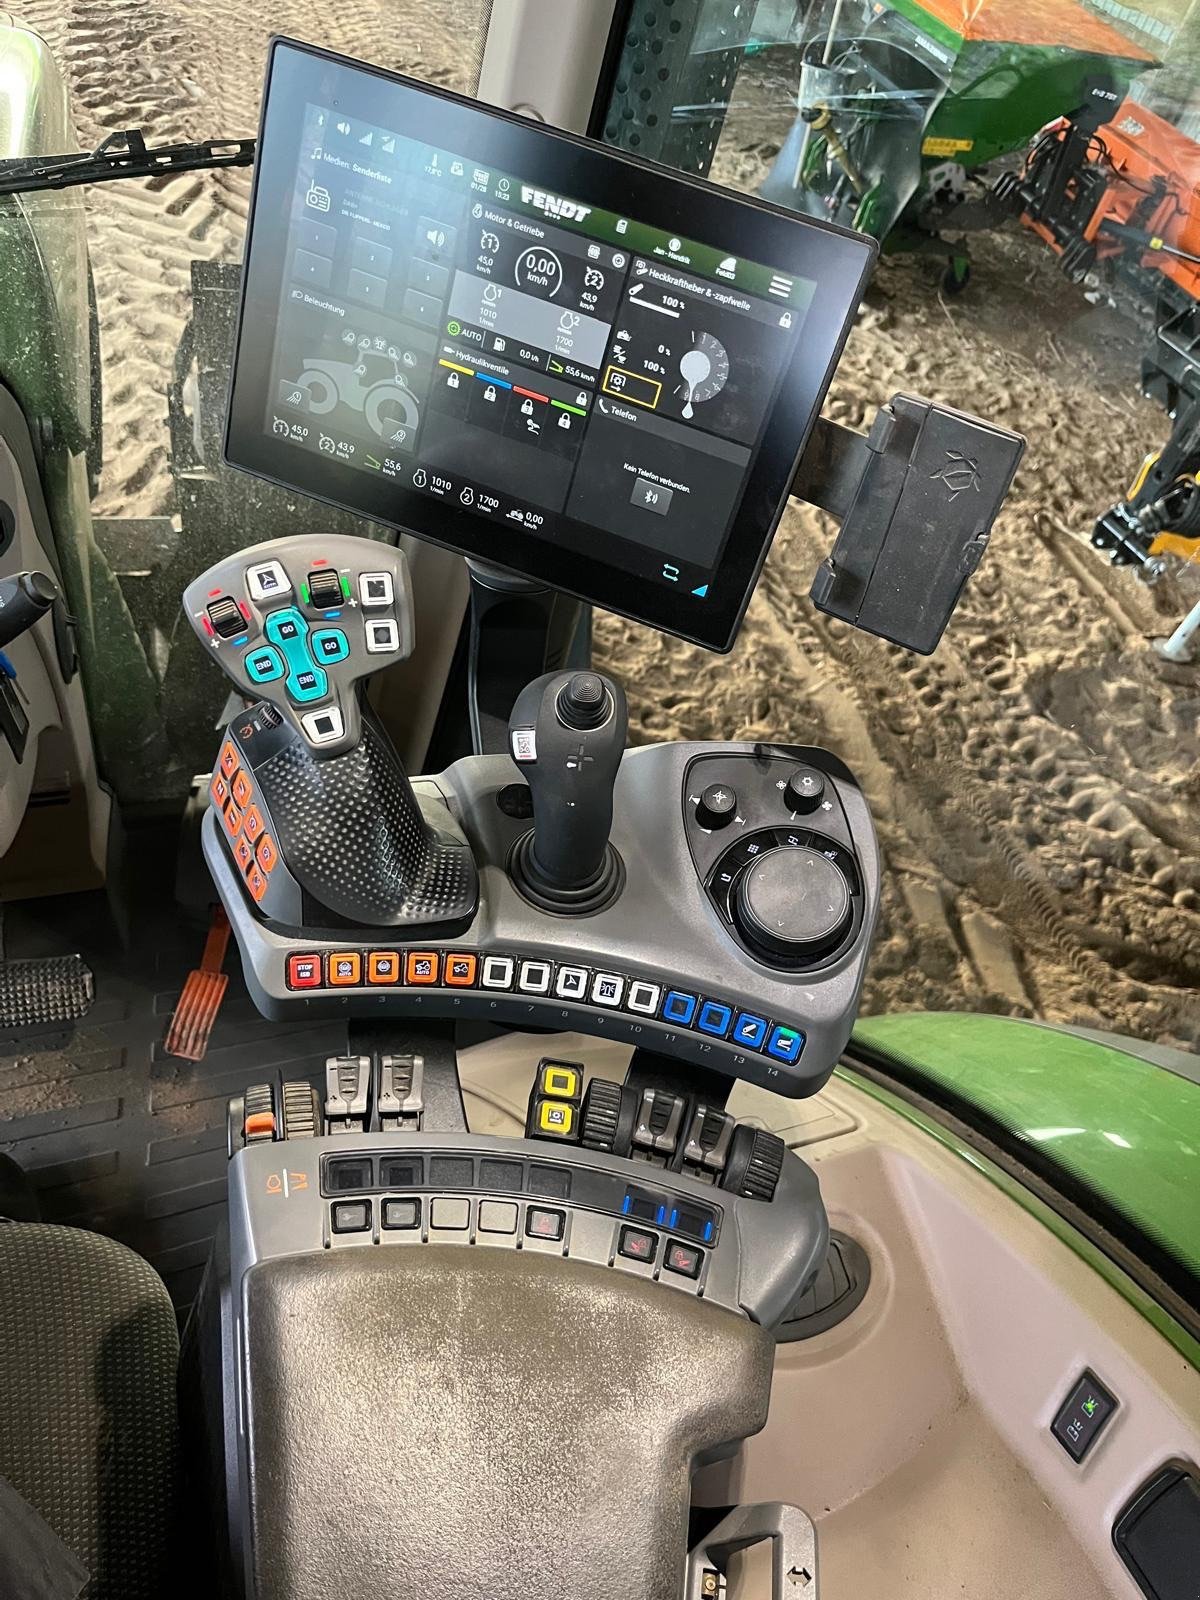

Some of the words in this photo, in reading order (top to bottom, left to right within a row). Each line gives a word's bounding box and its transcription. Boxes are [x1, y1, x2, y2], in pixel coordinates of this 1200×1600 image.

[352, 163, 392, 184] Senderliste
[521, 185, 591, 222] FENDT
[484, 210, 506, 224] Motor
[507, 218, 512, 227] &
[514, 220, 544, 238] Getriebe
[478, 255, 494, 267] 45,0
[526, 254, 556, 276] 0,00
[476, 264, 491, 275] km/h
[527, 272, 548, 286] km/h
[648, 268, 706, 294] Heckkraftheber
[706, 288, 712, 298] &
[582, 292, 598, 304] 43,9
[662, 296, 678, 308] 100
[304, 295, 345, 316] Beleuchtung
[580, 301, 594, 312] km/h
[480, 308, 497, 319] 1010
[462, 329, 482, 341] AUTO
[556, 336, 574, 347] 1700
[520, 350, 530, 359] 0,0
[658, 344, 664, 354] 0
[455, 350, 510, 376] Hydraulikventile
[643, 360, 660, 372] 100
[565, 365, 580, 377] 55,6
[580, 371, 595, 382] km/h
[610, 406, 637, 422] Telefon
[291, 425, 309, 437] 45,0
[338, 442, 355, 454] 43,9
[384, 458, 402, 472] 55,6
[432, 476, 452, 490] 1010
[624, 462, 637, 474] Kein
[638, 468, 659, 482] Telefon
[660, 476, 690, 494] verbunden.
[479, 494, 500, 508] 1700
[526, 512, 544, 525] 0,00
[282, 625, 294, 634] GO
[324, 642, 337, 650] GO
[256, 660, 272, 670] END
[298, 674, 314, 684] END
[630, 1024, 642, 1033] 10
[664, 1033, 676, 1042] 11
[699, 1044, 712, 1053] 12
[734, 1054, 746, 1064] 13
[767, 1067, 780, 1077] 14
